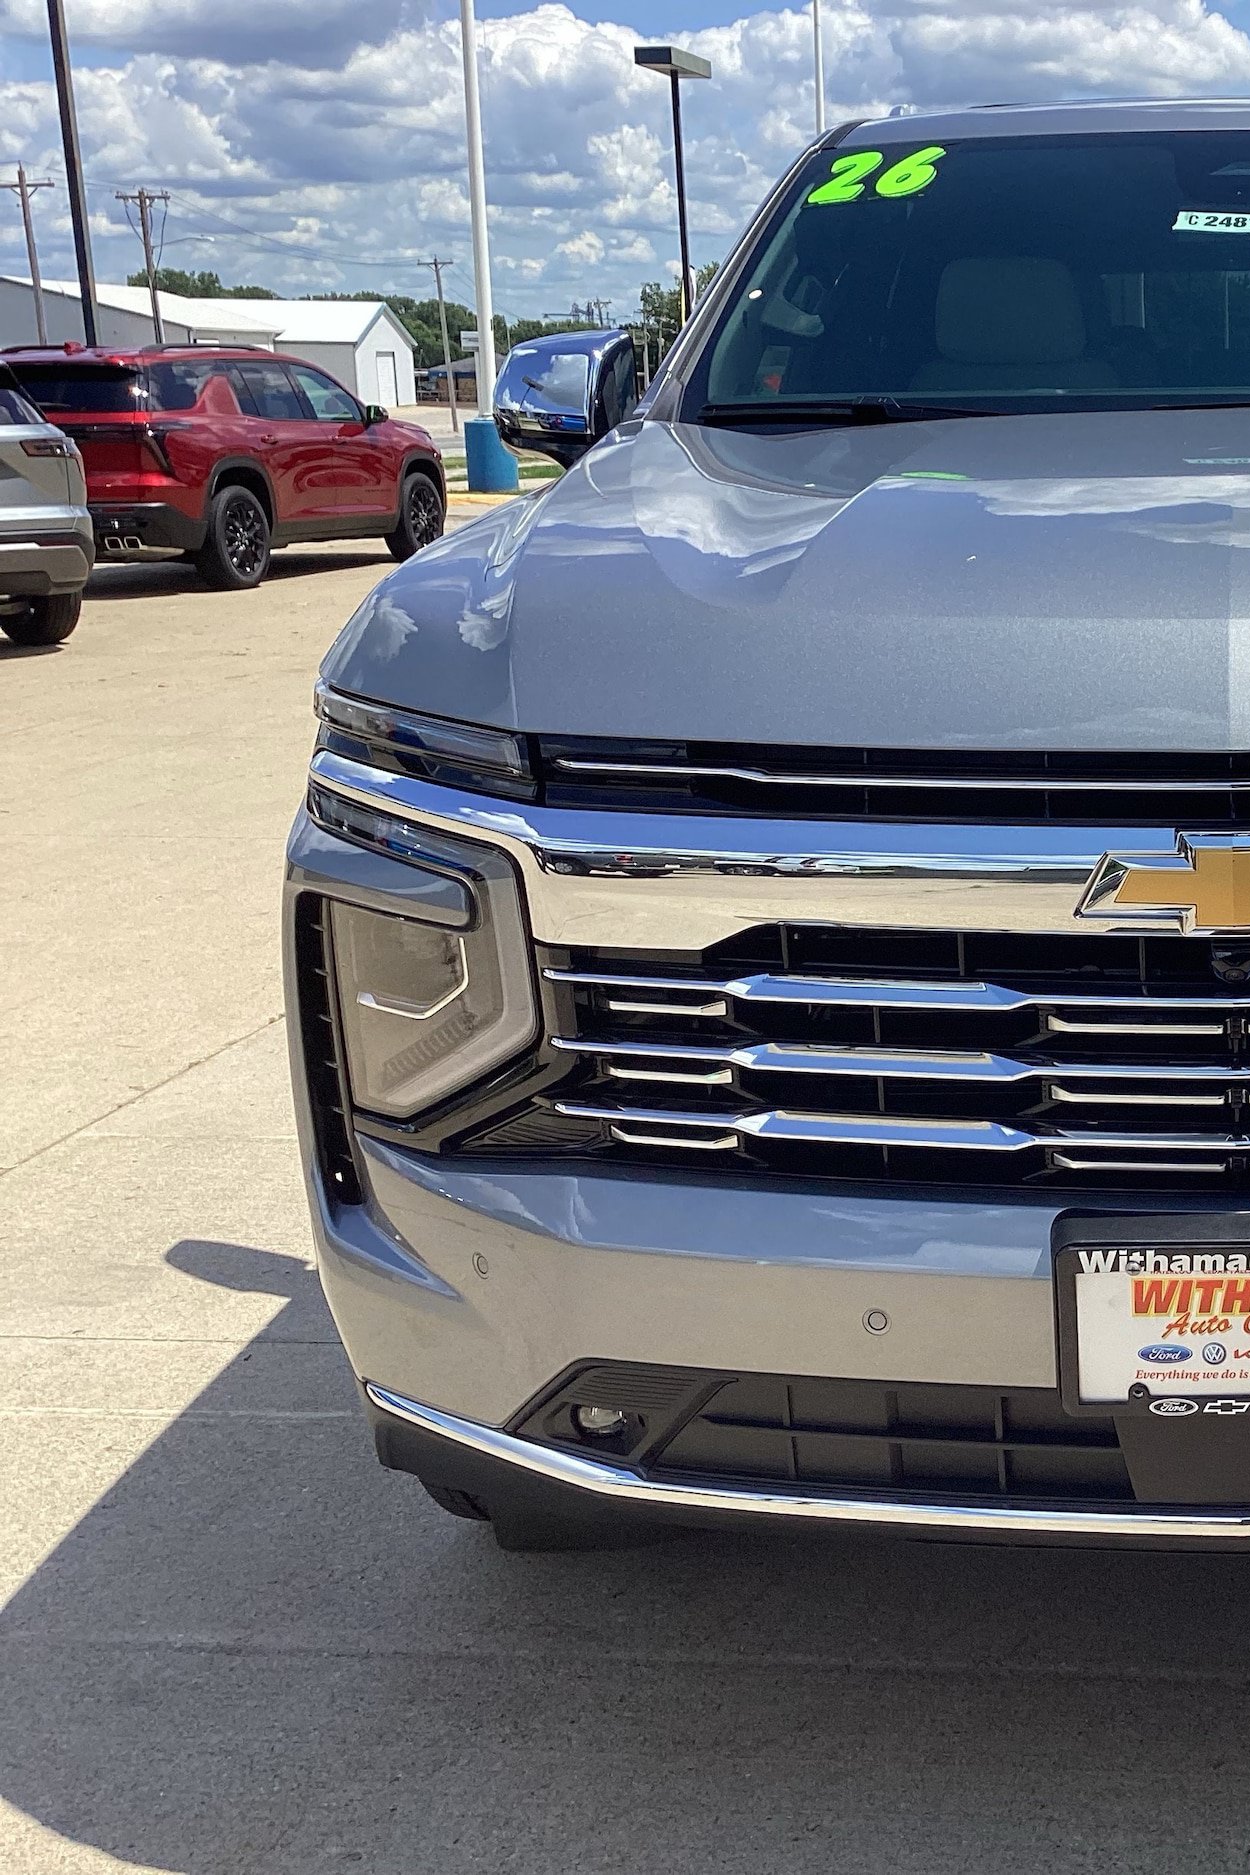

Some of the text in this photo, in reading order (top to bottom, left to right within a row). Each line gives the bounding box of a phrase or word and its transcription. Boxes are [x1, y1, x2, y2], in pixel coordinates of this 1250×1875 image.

[807, 146, 947, 205] 26
[1188, 214, 1200, 226] C
[1161, 1311, 1232, 1338] Auto
[1149, 1347, 1181, 1360] Ford
[1135, 1369, 1200, 1382] Everything
[1221, 1369, 1236, 1379] do
[1239, 1369, 1248, 1379] is
